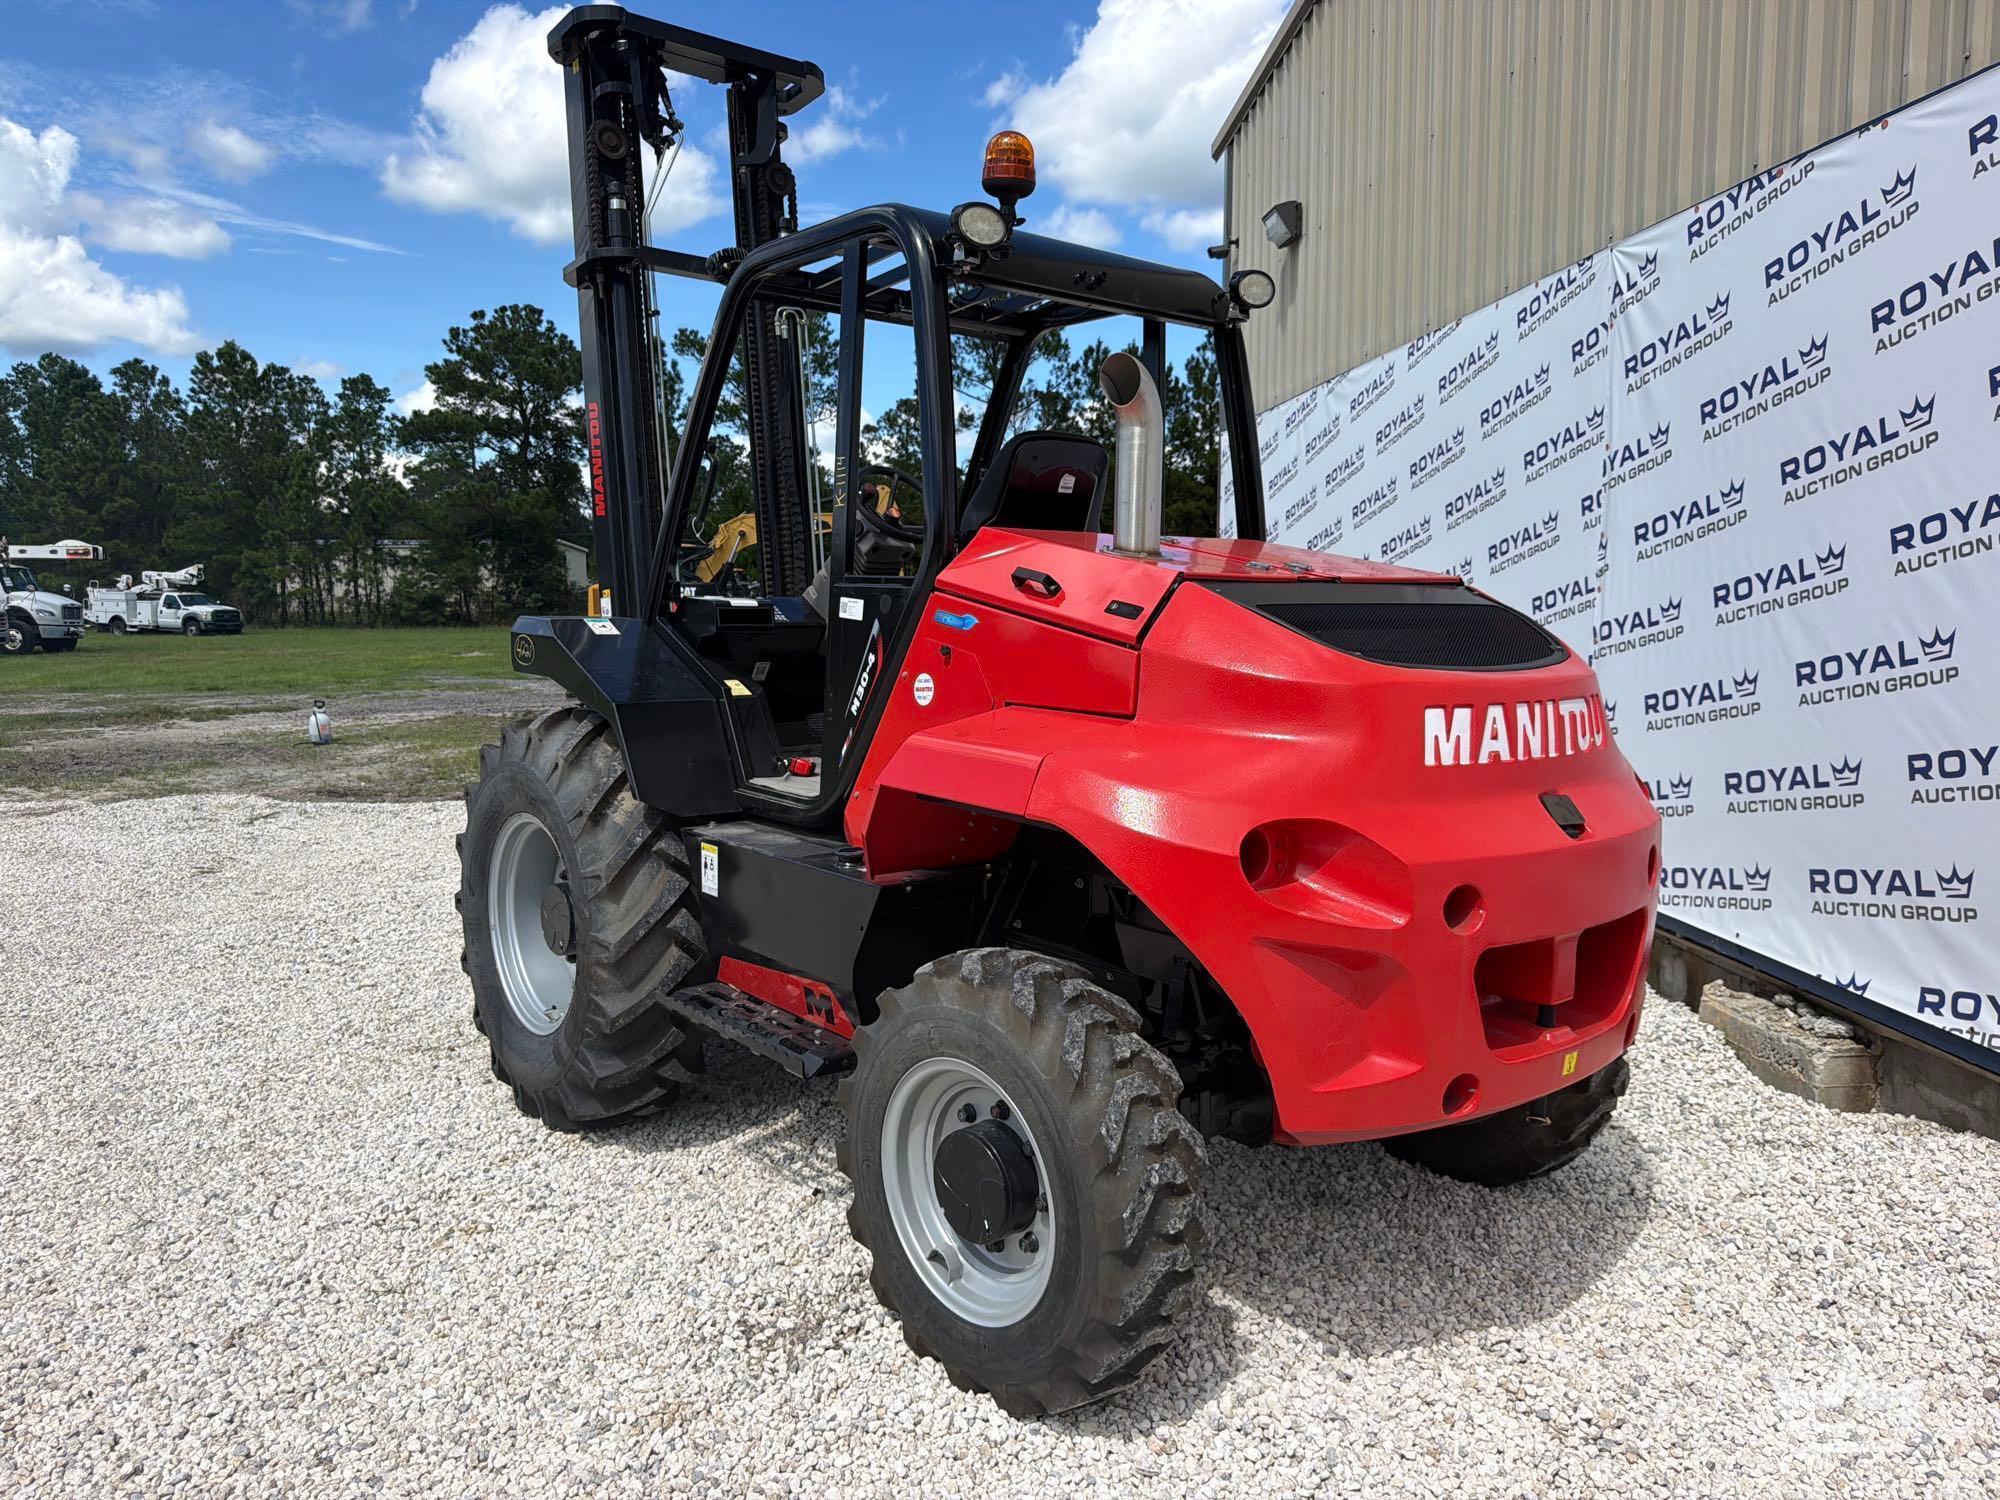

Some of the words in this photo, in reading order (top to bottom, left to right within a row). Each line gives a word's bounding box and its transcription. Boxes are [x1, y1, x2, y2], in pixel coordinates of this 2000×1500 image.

[1690, 206, 1753, 263] AUCTION
[1757, 160, 1815, 212] GROUP
[1764, 199, 1880, 289] ROYAL
[1768, 248, 1844, 308] AUCTION
[1849, 201, 1919, 256] GROUP
[1516, 268, 1577, 329] ROYAL
[1518, 306, 1559, 343] AUCTION
[1560, 272, 1596, 308] GROUP
[1619, 277, 1660, 315] GROUP
[1875, 292, 1971, 355] AUCTION
[1407, 342, 1436, 373] AUCTION
[1573, 345, 1608, 377] AUCTI
[1624, 313, 1707, 379] ROYAL
[1626, 352, 1681, 396] AUCTION
[1684, 320, 1733, 360] GROUP
[1438, 345, 1485, 394] ROYAL
[1439, 376, 1471, 406] AUCTION
[1472, 352, 1499, 380] GROUP
[1350, 373, 1385, 414] ROYAL
[1350, 397, 1374, 424] AUCTION
[1375, 379, 1395, 401] GROUP
[1480, 378, 1535, 428] ROYAL
[1700, 356, 1799, 425] ROYAL
[1703, 399, 1768, 443] AUCTION
[1772, 366, 1831, 407] GROUP
[1285, 394, 1311, 430] ROYAL
[1375, 405, 1414, 446] ROYAL
[1481, 409, 1518, 441] AUCTION
[1519, 385, 1552, 414] GROUP
[1260, 437, 1273, 455] YAL
[1305, 422, 1334, 456] ROYAL
[1376, 431, 1402, 456] AUCTION
[1403, 412, 1425, 435] GROUP
[1523, 421, 1586, 471] ROYAL
[1780, 416, 1900, 486] ROYAL
[588, 402, 606, 516] MANITOU
[1268, 463, 1293, 492] ROYAL
[1325, 453, 1356, 488] ROYAL
[1409, 438, 1453, 480] ROYAL
[1411, 466, 1440, 491] AUCTION
[1440, 447, 1466, 471] GROUP
[1525, 453, 1567, 485] AUCTION
[1602, 438, 1649, 478] YAL
[1629, 449, 1672, 480] GROUP
[1783, 462, 1862, 506] AUCTION
[1866, 430, 1939, 472] GROUP
[1326, 477, 1346, 498] AUCTION
[1346, 461, 1365, 481] GROUP
[1445, 478, 1492, 520] ROYAL
[1285, 495, 1311, 522] ROYAL
[1352, 486, 1387, 520] ROYAL
[1353, 510, 1377, 530] AUCTION
[1377, 494, 1398, 514] GROUP
[1446, 505, 1478, 532] AUCTION
[1479, 488, 1507, 512] GROUP
[1634, 494, 1720, 546] ROYAL
[1306, 525, 1334, 551] ROYAL
[1380, 525, 1420, 558] ROYAL
[1409, 534, 1432, 553] GROUP
[1488, 523, 1542, 563] ROYAL
[1637, 531, 1694, 562] AUCTION
[1697, 509, 1747, 538] GROUP
[1890, 493, 2000, 555] ROYA
[1490, 550, 1526, 576] AUCTION
[1528, 535, 1560, 558] GROUP
[1894, 534, 1992, 577] AUCTION
[1532, 576, 1595, 615] ROYAL
[1713, 558, 1816, 608] ROYAL
[1715, 596, 1783, 627] AUCTION
[1787, 577, 1849, 606] GROUP
[1593, 607, 1660, 645] OYAL
[1593, 635, 1636, 660] UCTION
[1639, 625, 1684, 648] GROUP
[1795, 640, 1919, 687] ROYAL
[850, 652, 875, 717] M30-4
[1644, 679, 1732, 715] ROYAL
[1798, 680, 1880, 707] AUCTION
[1884, 666, 1959, 693] GROUP
[1424, 698, 1604, 767] MANITOU
[1646, 711, 1705, 732] AUCTION
[1708, 702, 1761, 722] GROUP
[1724, 764, 1830, 795] ROYAL
[1908, 746, 2000, 781] ROY
[1657, 804, 1694, 818] ROUP
[1726, 797, 1797, 814] AUCTION
[1800, 793, 1865, 810] GROUP
[1808, 868, 1936, 898] ROYAL
[1717, 897, 1772, 911] GROUP
[1811, 901, 1896, 919] AUCTION
[1901, 905, 1977, 923] GROUP
